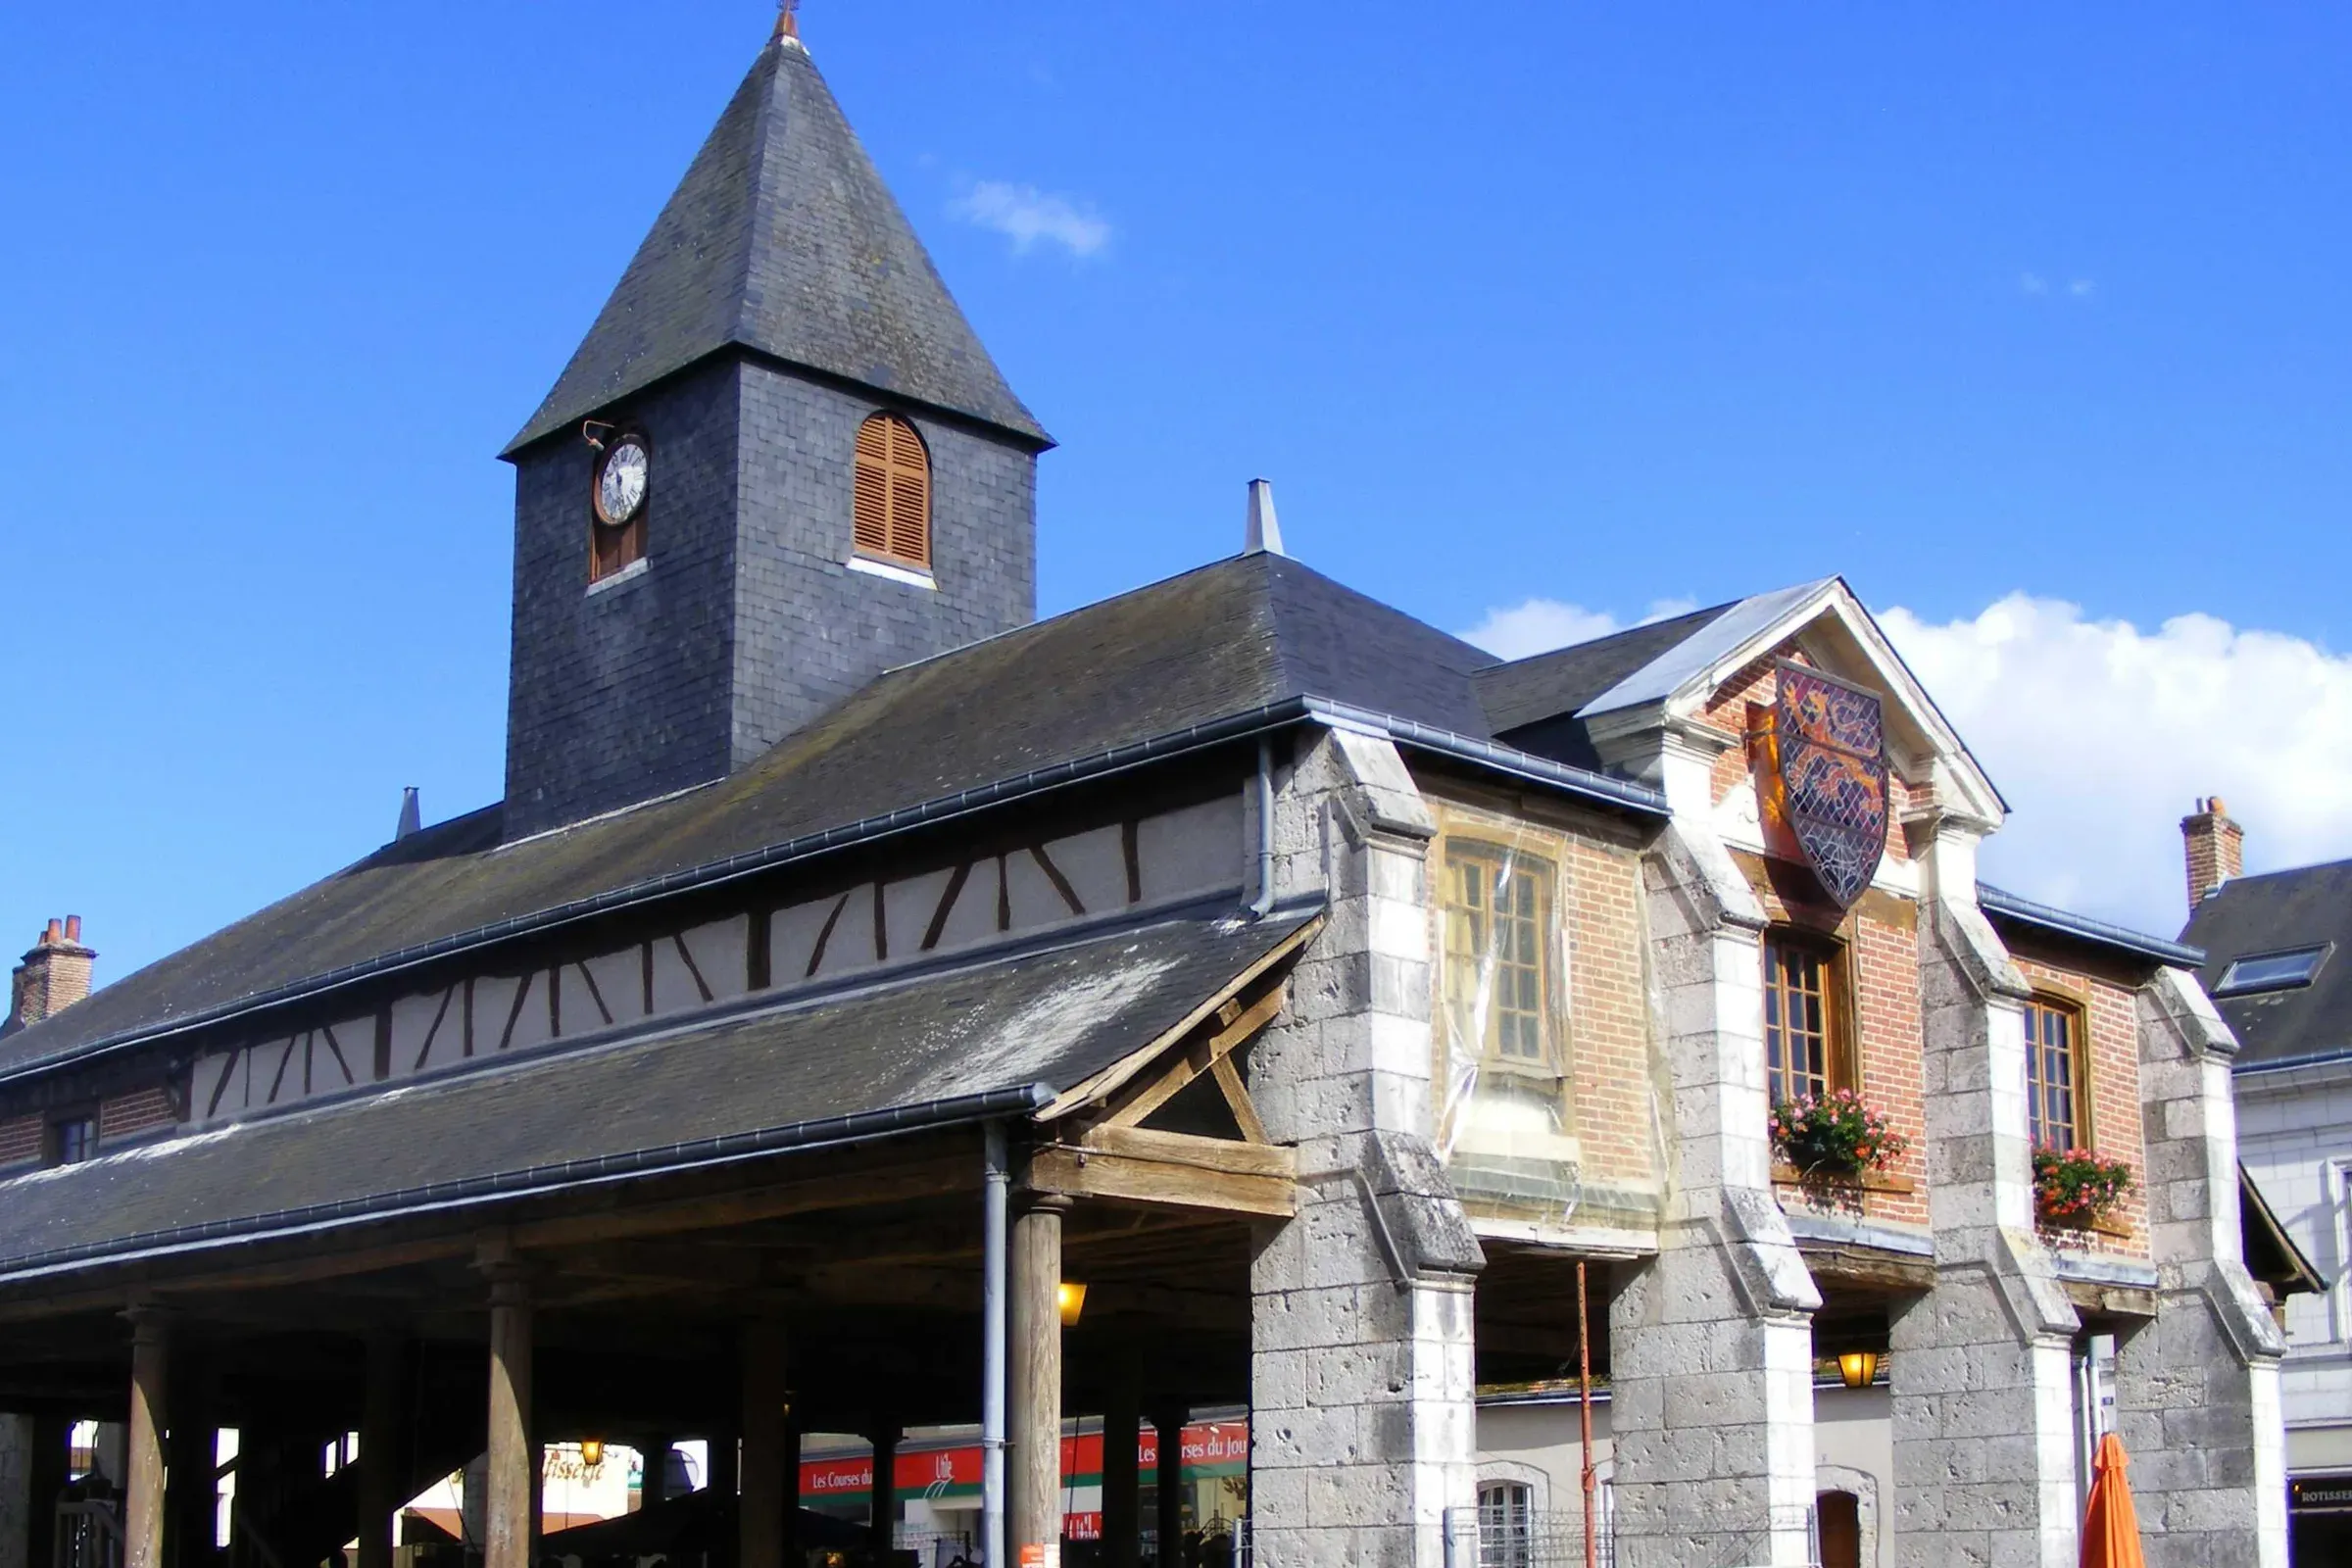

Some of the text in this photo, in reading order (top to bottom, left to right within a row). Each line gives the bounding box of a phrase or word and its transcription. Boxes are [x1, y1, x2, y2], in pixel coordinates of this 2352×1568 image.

[1138, 1435, 1248, 1462] Les rses du Jou
[544, 1454, 606, 1481] tisserie
[812, 1472, 826, 1489] Les
[828, 1471, 860, 1488] Courses
